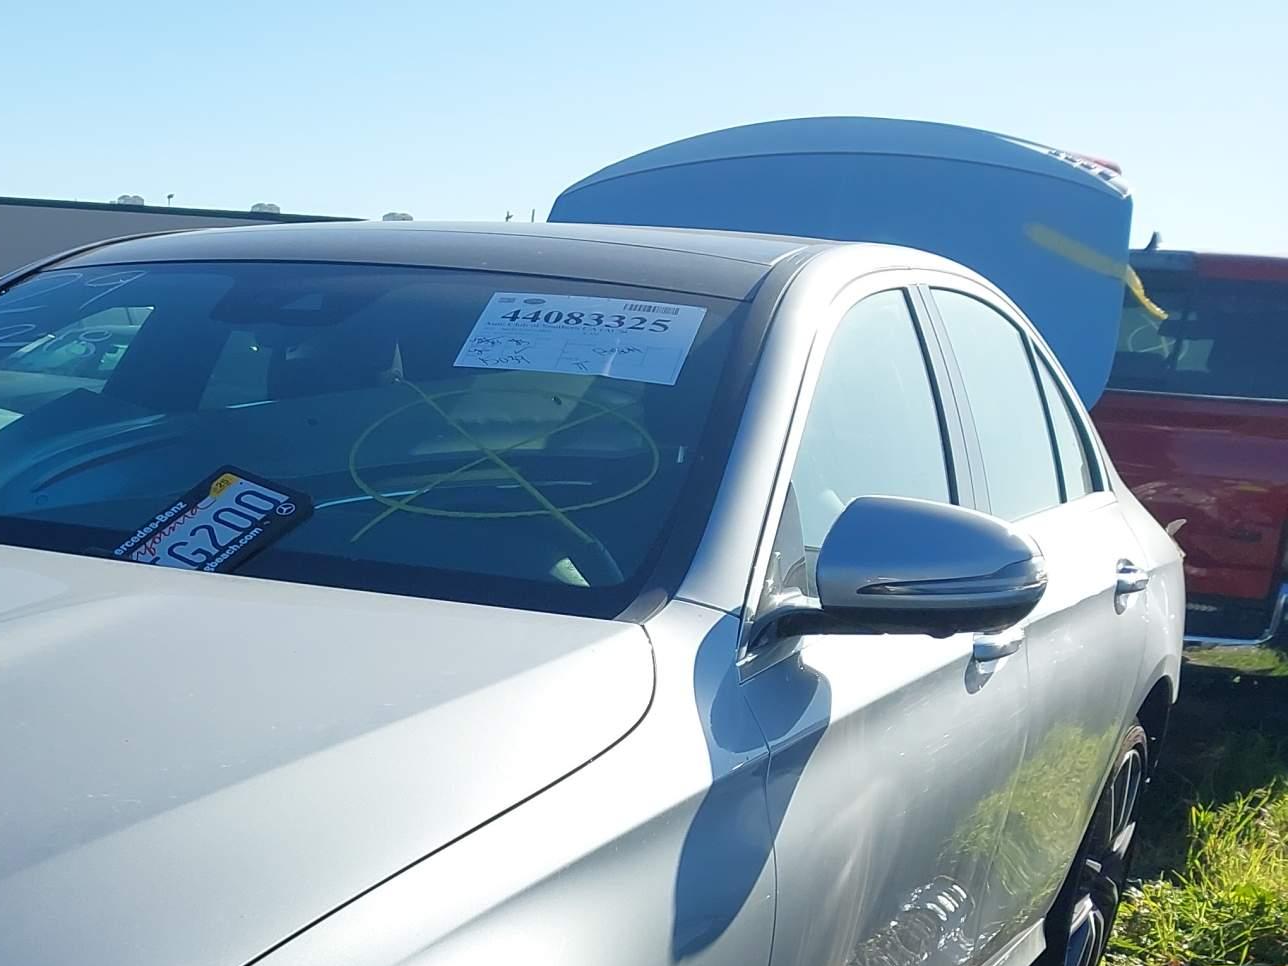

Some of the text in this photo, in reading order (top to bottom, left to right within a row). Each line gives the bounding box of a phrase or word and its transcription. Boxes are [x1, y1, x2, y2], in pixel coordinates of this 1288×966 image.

[500, 308, 672, 333] 44083325
[114, 501, 187, 556] ercedes-Benz
[203, 526, 263, 571] gbeach.com
